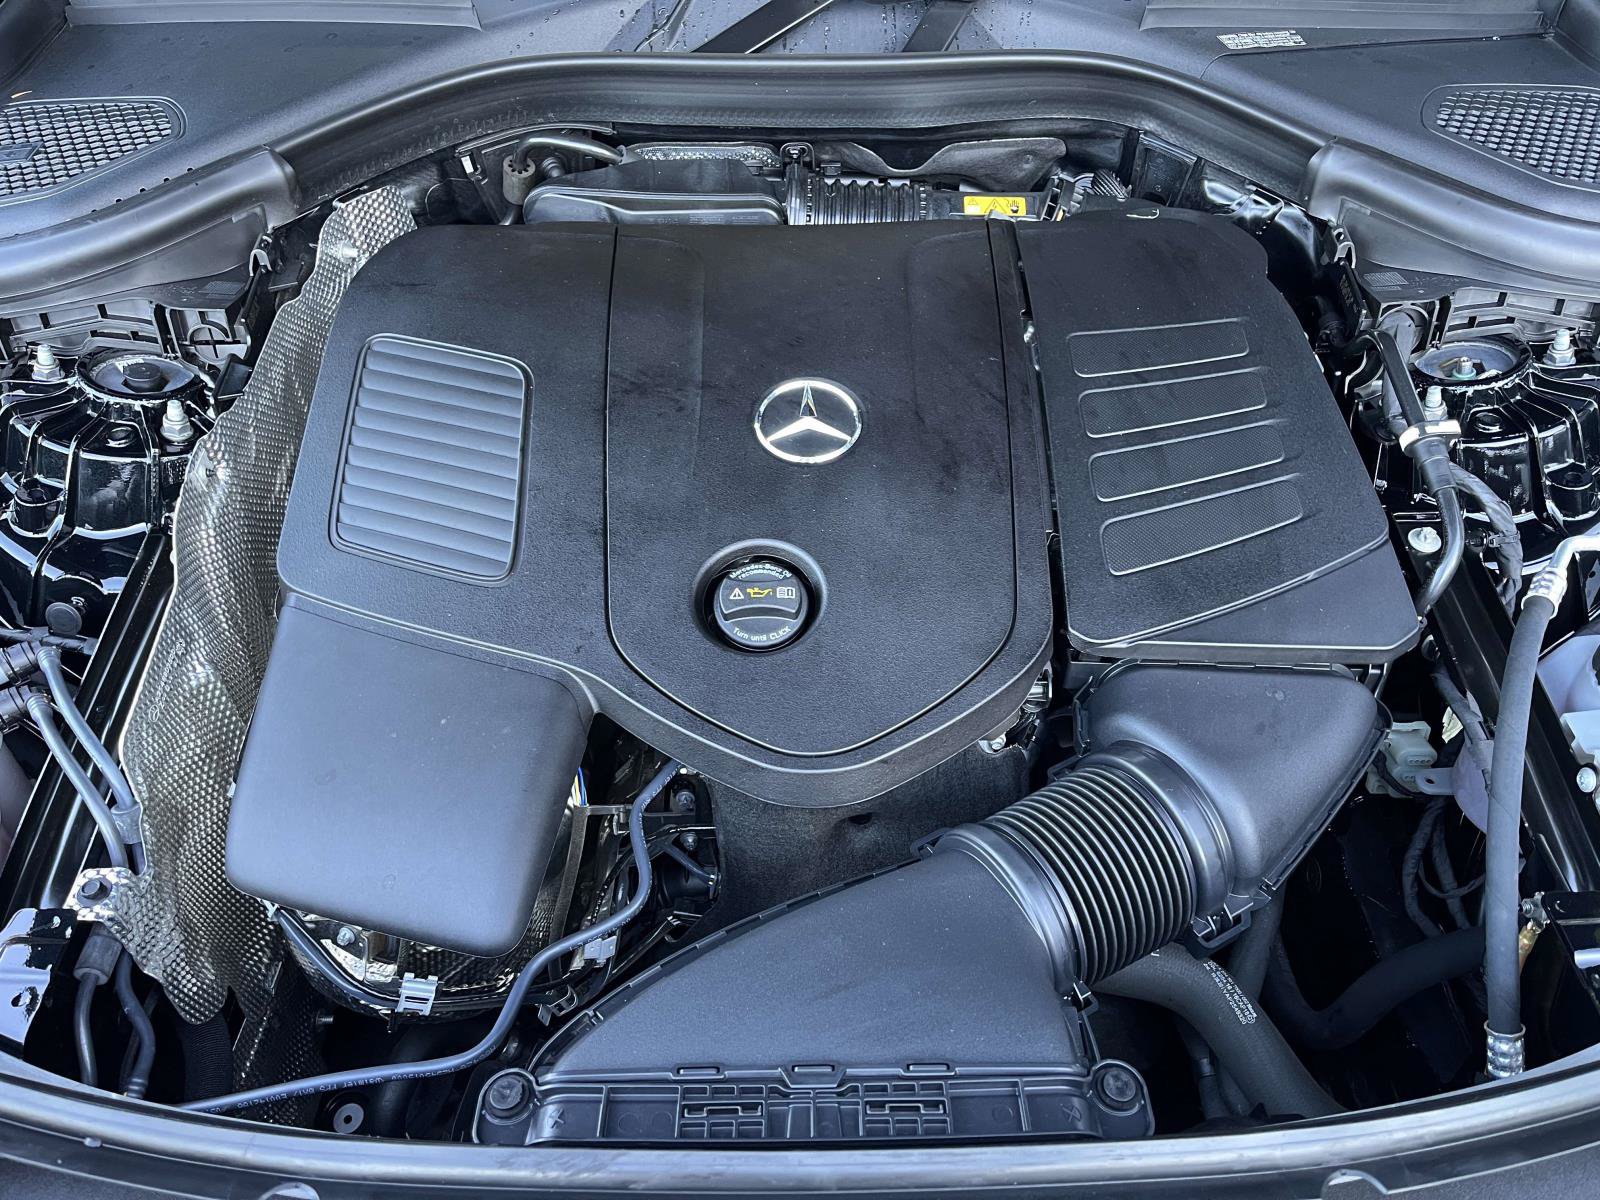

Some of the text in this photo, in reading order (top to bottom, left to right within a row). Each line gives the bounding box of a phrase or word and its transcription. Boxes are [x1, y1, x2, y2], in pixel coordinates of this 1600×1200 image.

[729, 563, 782, 579] Mercedes-Benz
[738, 568, 785, 580] recommended
[733, 625, 792, 642] Turn until CLICK
